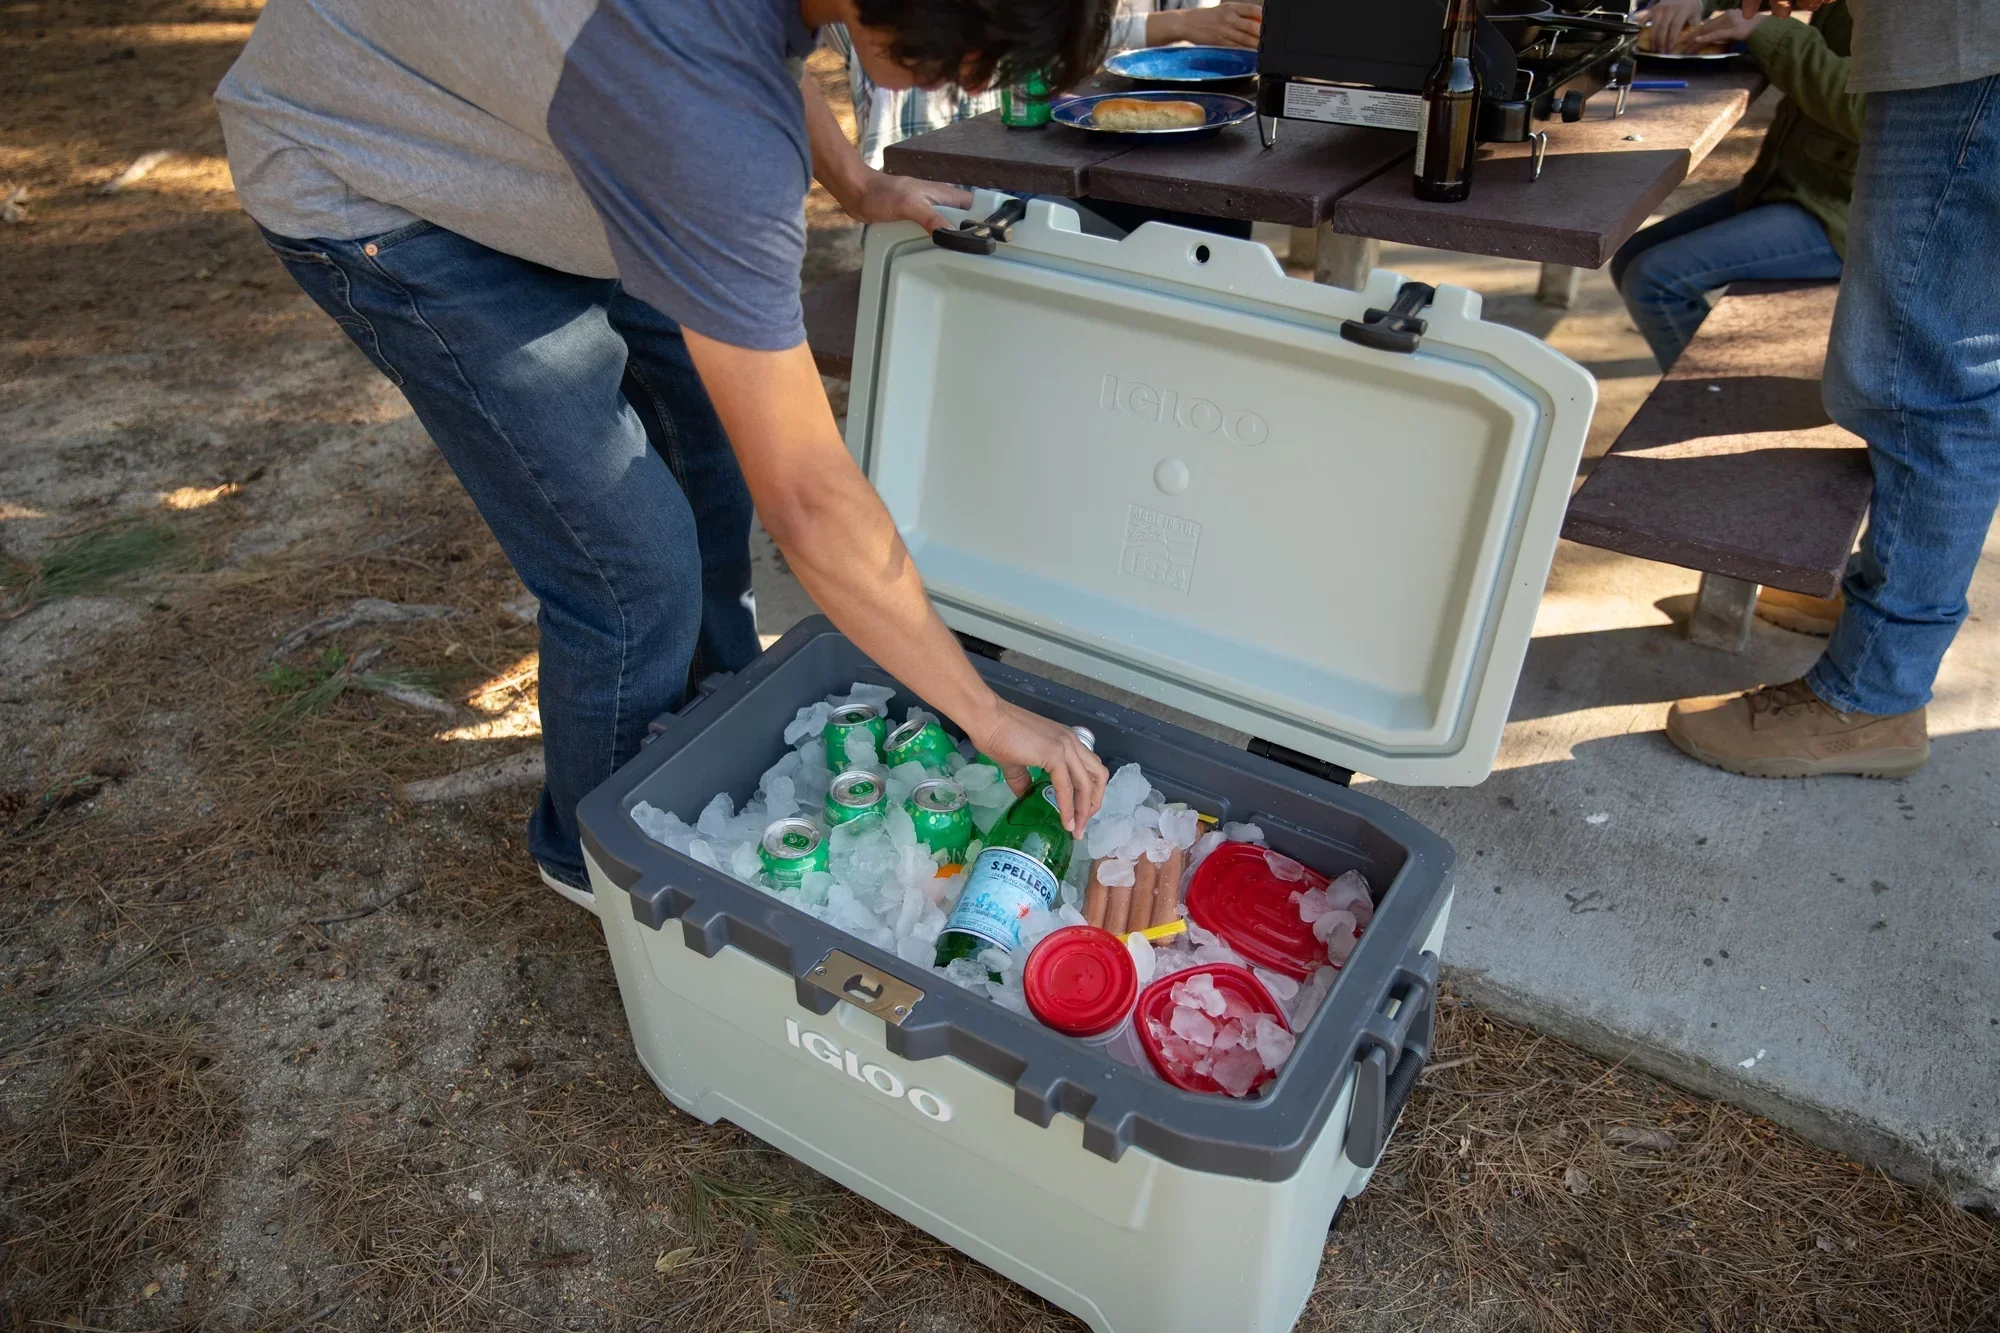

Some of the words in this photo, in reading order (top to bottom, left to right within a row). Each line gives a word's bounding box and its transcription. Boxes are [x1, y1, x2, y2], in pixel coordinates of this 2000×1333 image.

[1100, 374, 1269, 447] IGLOO
[991, 860, 1053, 909] S.PELLEGR
[786, 1017, 952, 1122] IGLOO
